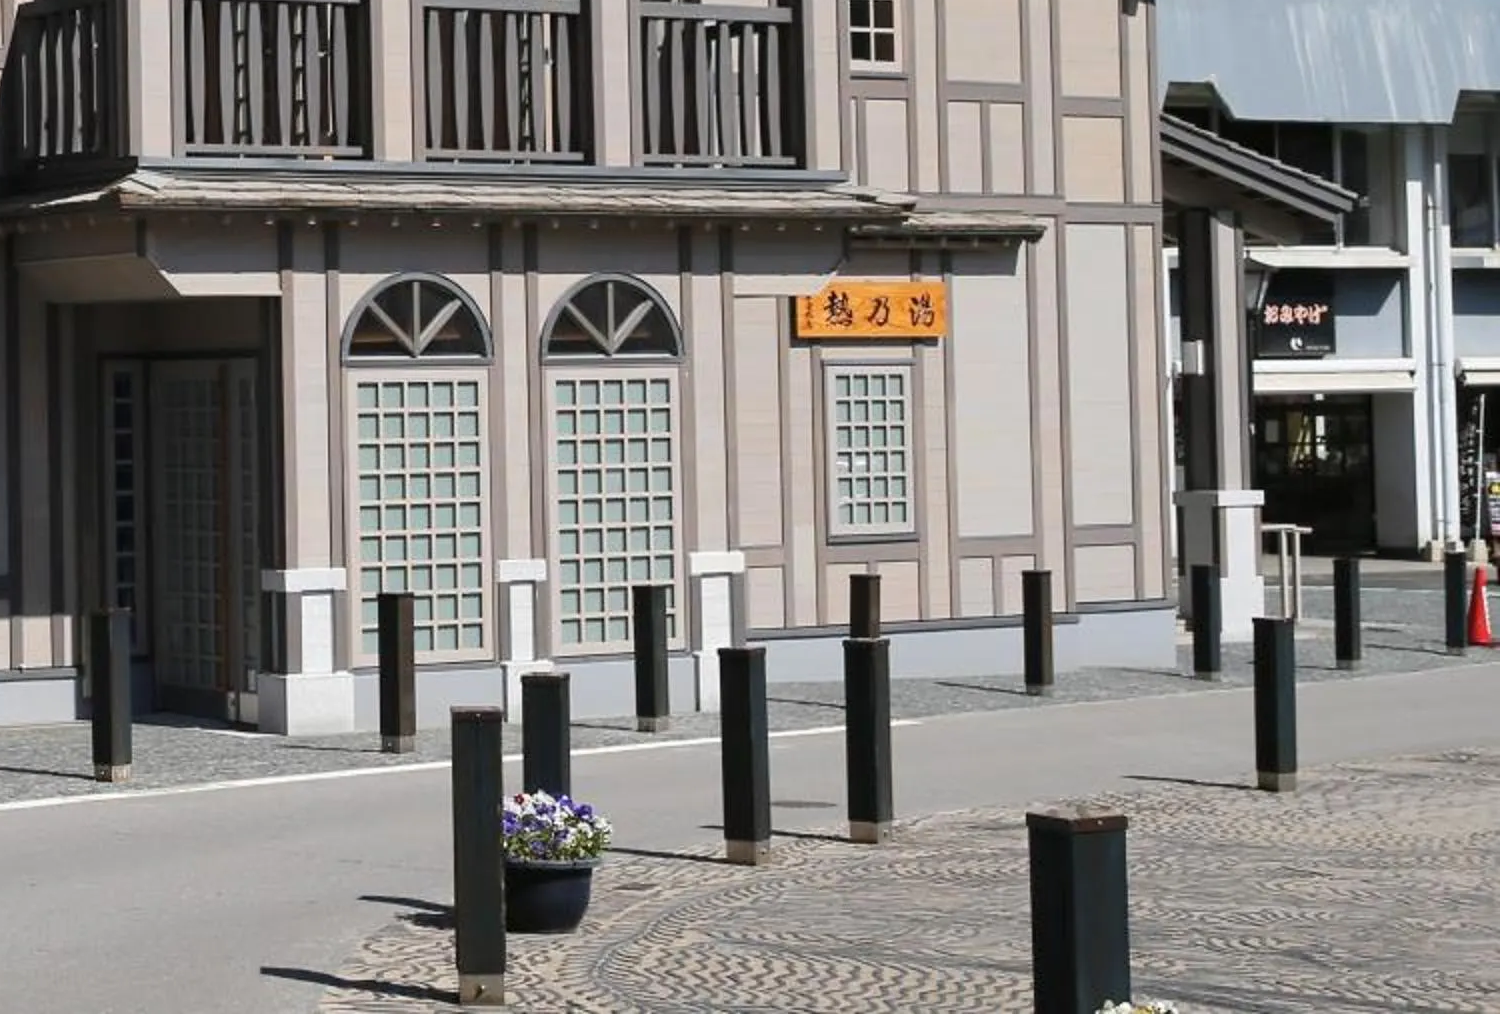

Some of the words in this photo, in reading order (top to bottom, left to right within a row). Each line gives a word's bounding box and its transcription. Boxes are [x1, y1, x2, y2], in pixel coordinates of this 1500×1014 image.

[823, 290, 935, 327] 熱乃湯
[1264, 303, 1328, 325] おみやげ
